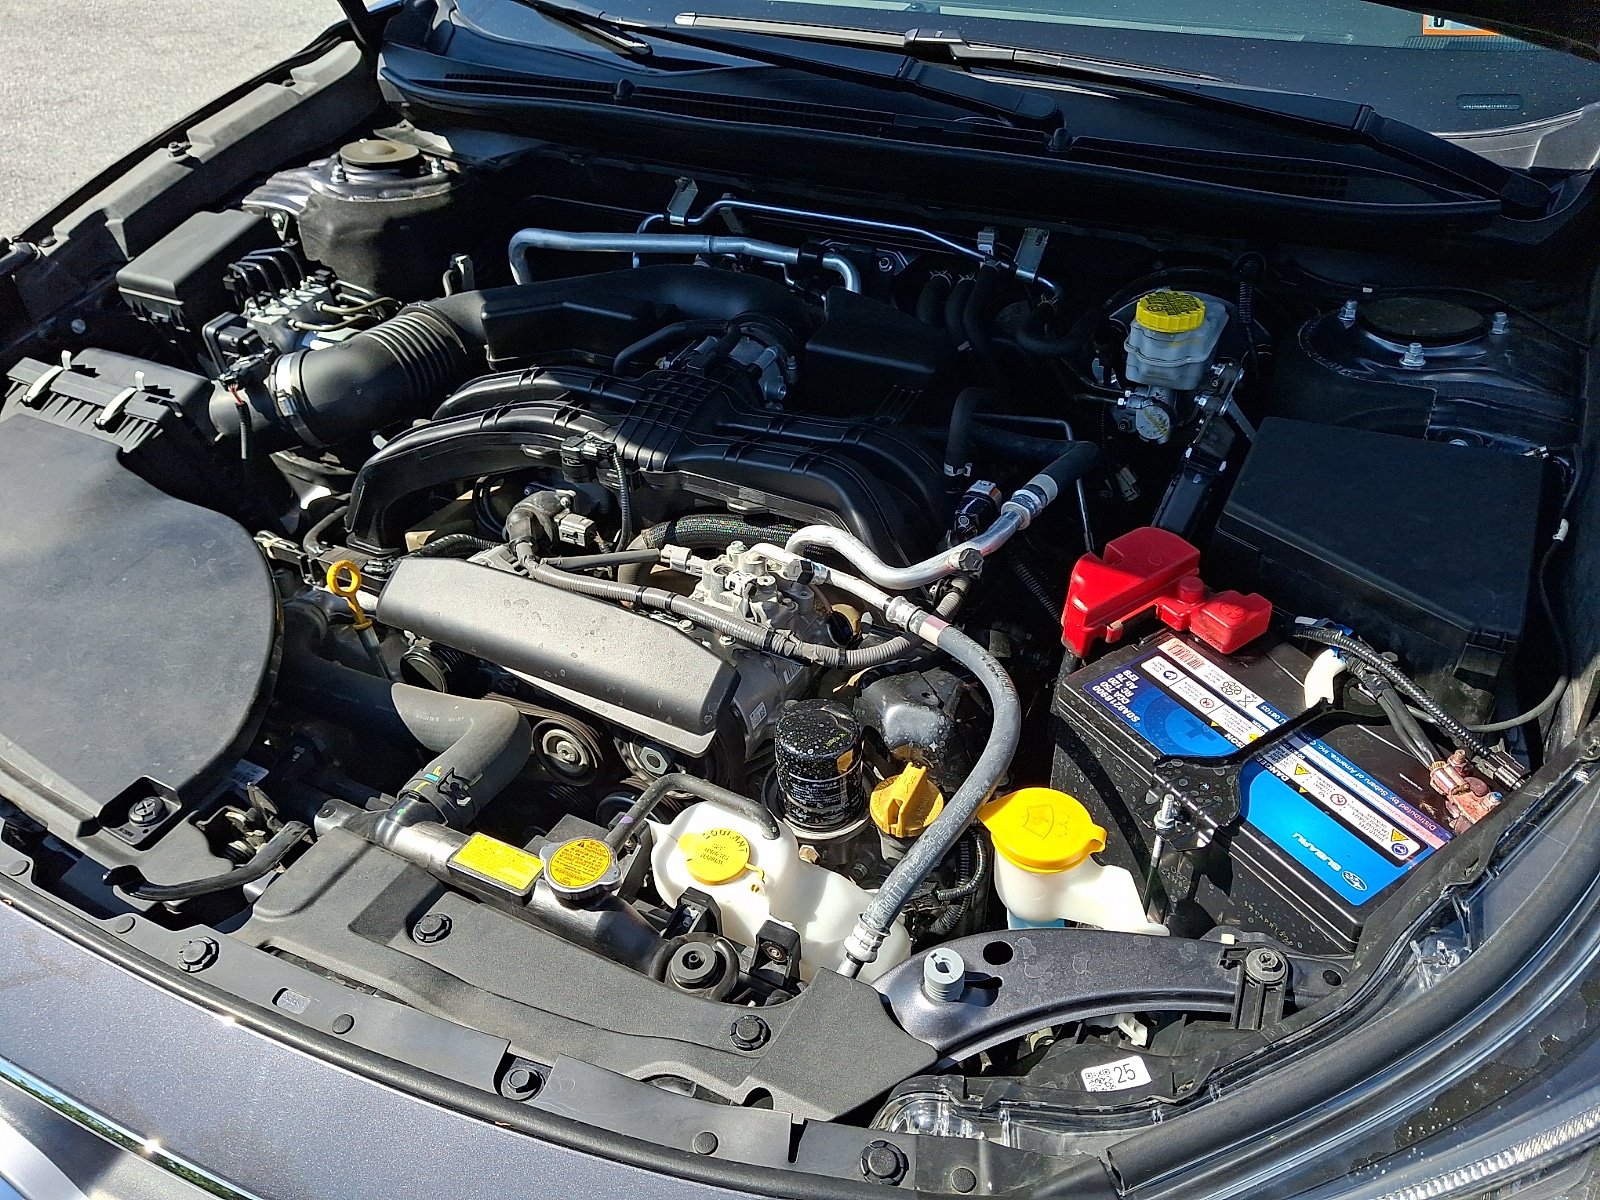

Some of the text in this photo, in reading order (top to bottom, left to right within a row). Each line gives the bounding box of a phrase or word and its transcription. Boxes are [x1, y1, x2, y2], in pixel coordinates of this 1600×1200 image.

[1121, 668, 1140, 682] EFB
[1123, 679, 1139, 690] Ah
[1098, 680, 1131, 705] CCA 750
[1106, 676, 1134, 698] RC 120
[1354, 771, 1364, 779] of
[1363, 777, 1388, 797] Subaru
[1397, 801, 1437, 831] Distributed
[1290, 831, 1342, 872] SUBARU
[1113, 1063, 1136, 1084] 25
